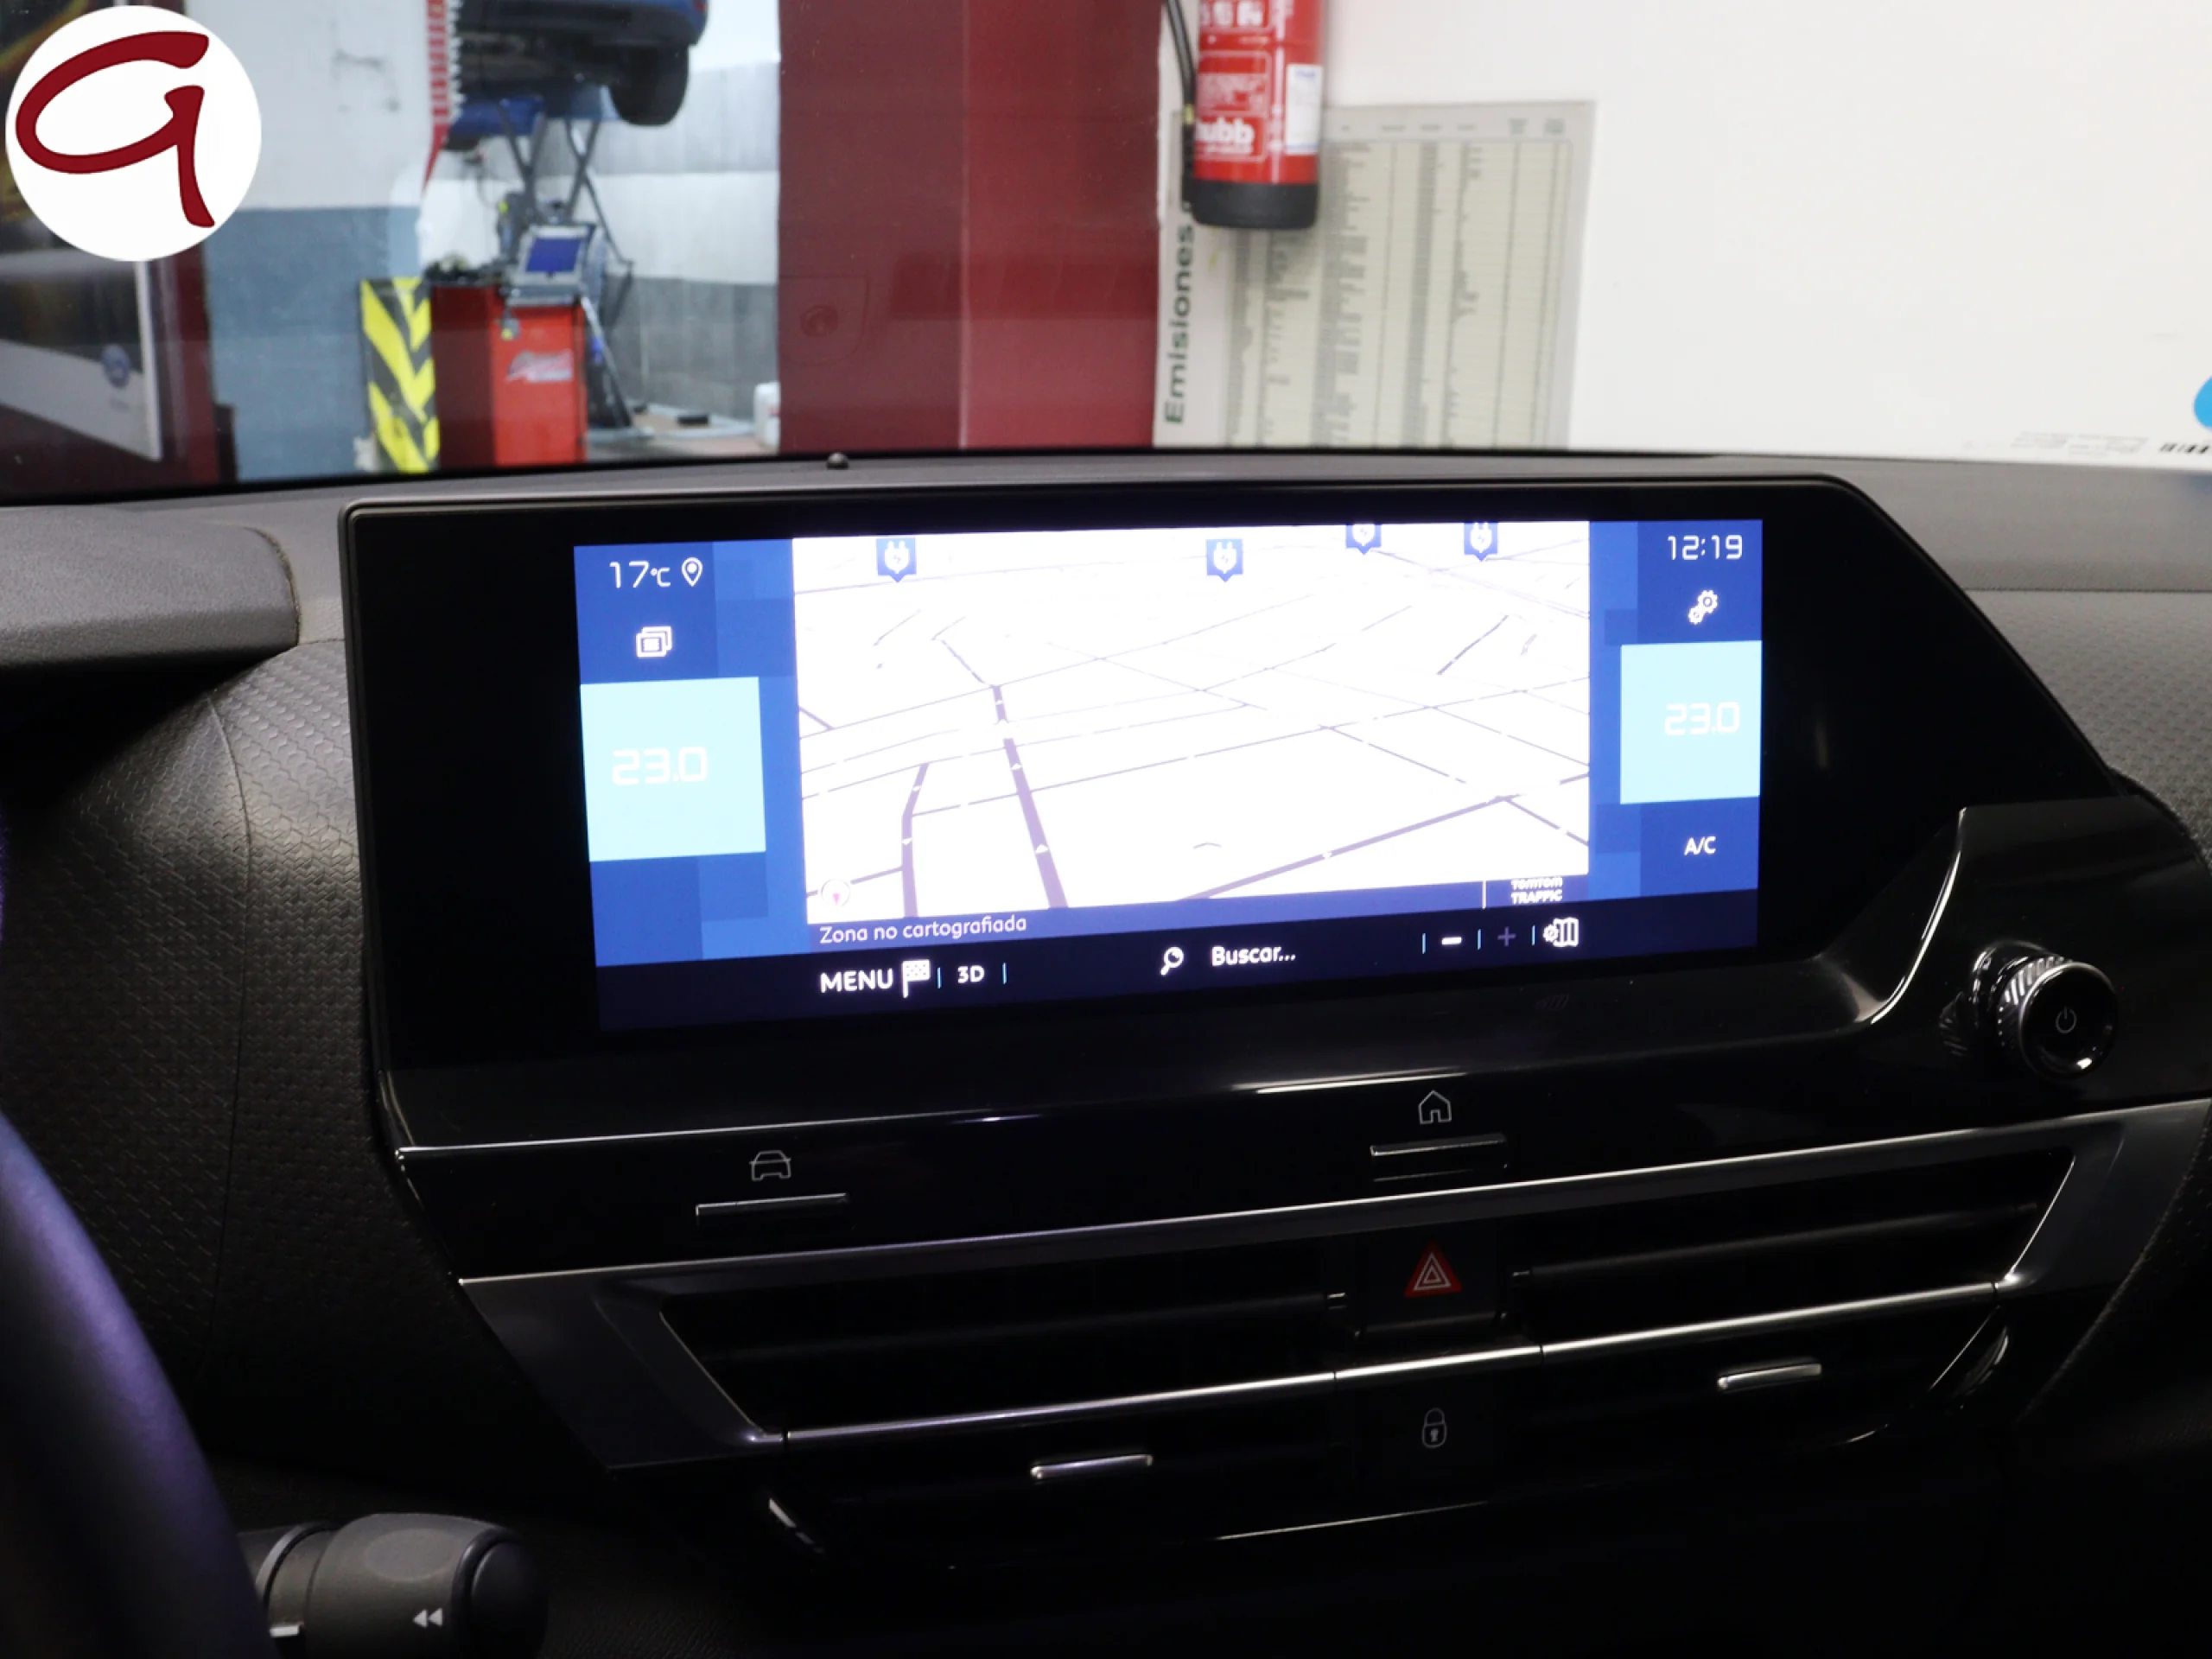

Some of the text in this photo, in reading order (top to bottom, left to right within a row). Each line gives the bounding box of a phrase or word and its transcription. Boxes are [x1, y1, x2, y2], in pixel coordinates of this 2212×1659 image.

[1164, 225, 1197, 424] Emisiones
[1667, 534, 1744, 561] 12:19
[1664, 701, 1741, 736] 23.0
[612, 746, 709, 785] 23.0
[1684, 836, 1717, 856] A/C
[1510, 889, 1563, 906] TRAFFIC
[819, 914, 1028, 944] Zona no cartografiada
[1211, 945, 1296, 966] Buscar...
[820, 967, 894, 993] MENU
[957, 965, 985, 983] 3D
